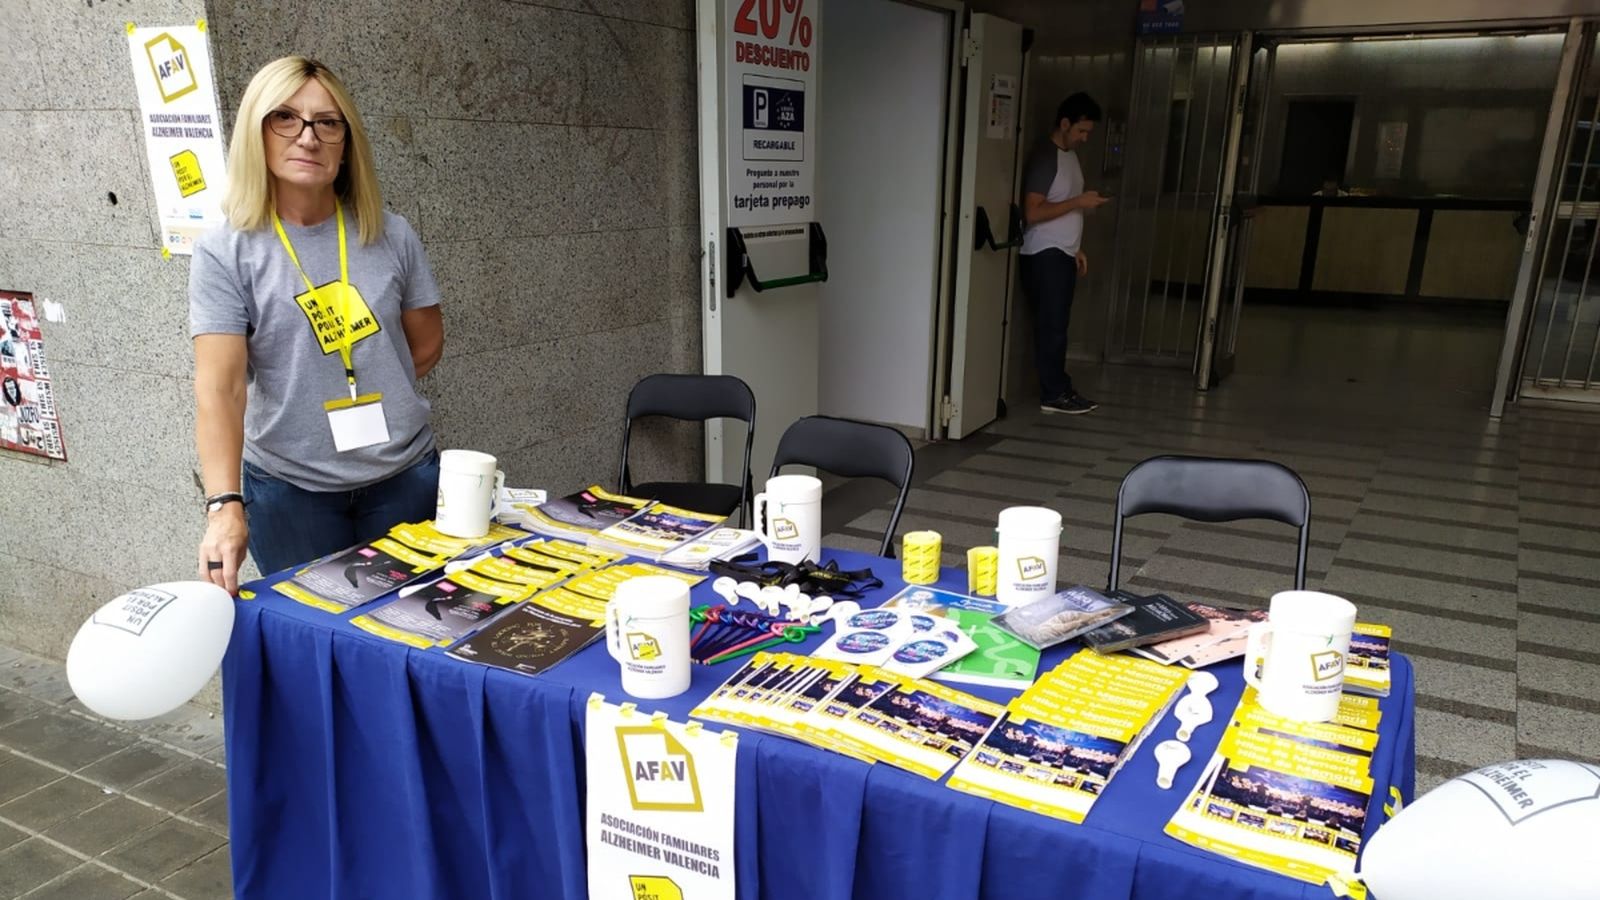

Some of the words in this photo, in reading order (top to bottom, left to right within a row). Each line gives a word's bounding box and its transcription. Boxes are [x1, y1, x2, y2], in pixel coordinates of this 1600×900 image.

[734, 0, 813, 48] 20%
[736, 41, 810, 72] DESCUENTO
[158, 53, 185, 81] AFAV
[756, 92, 767, 120] P
[753, 139, 796, 151] RECARGABLE
[753, 180, 778, 191] personal
[779, 182, 788, 190] por
[734, 194, 769, 211] tarjeta
[772, 195, 810, 210] prepago
[304, 298, 318, 310] UN
[1319, 659, 1341, 671] AFAV
[635, 761, 685, 781] AFAV
[1513, 769, 1532, 780] EL
[601, 812, 660, 843] ASOCIACIÓN
[661, 833, 720, 862] FAMILIARES
[601, 829, 661, 861] ALZHEIMER
[663, 849, 720, 879] VALENCIA
[635, 883, 646, 891] UN
